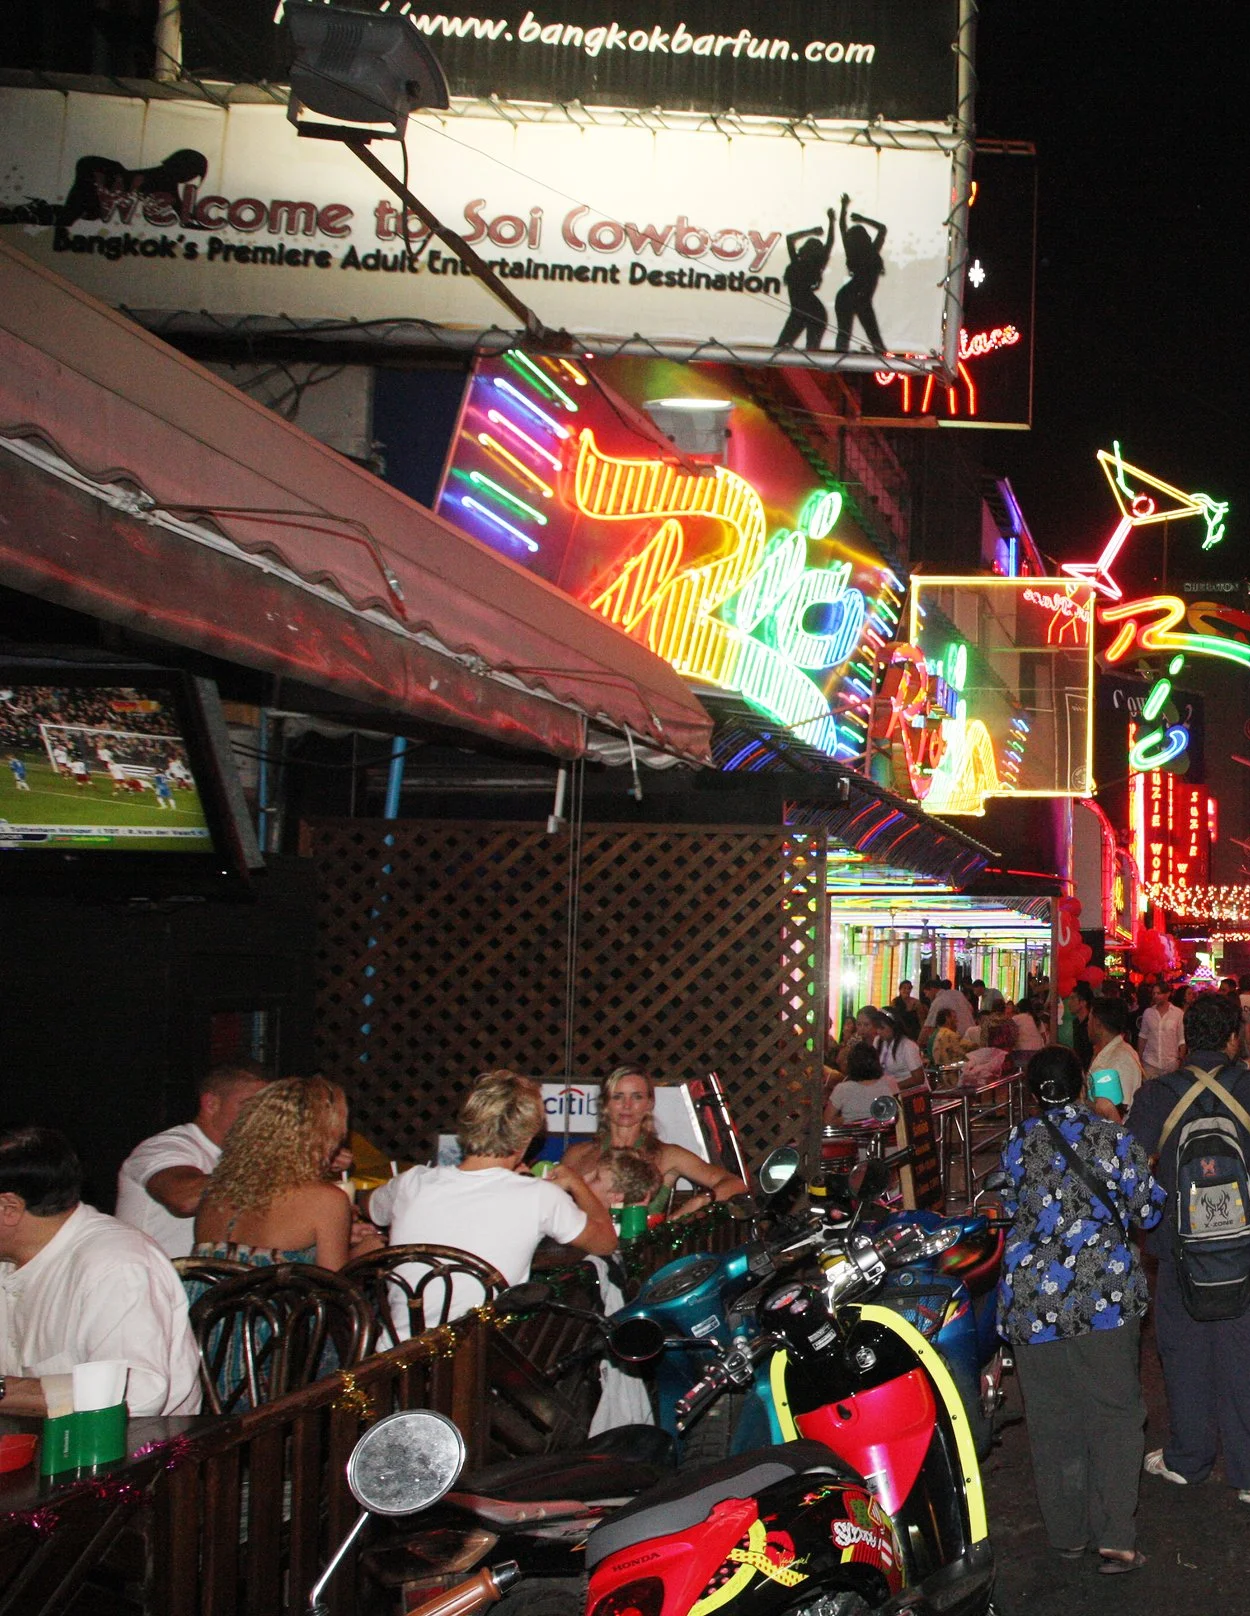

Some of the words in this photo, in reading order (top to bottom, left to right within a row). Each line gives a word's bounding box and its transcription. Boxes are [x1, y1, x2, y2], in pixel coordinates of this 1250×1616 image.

[96, 172, 353, 238] Welcome
[374, 199, 433, 242] to
[462, 199, 544, 250] Soi
[562, 204, 782, 273] Cowboy
[53, 226, 199, 261] Bangkok's
[208, 236, 332, 268] Premiere
[341, 248, 420, 274] Adult
[428, 250, 620, 286] Entrtainment
[629, 261, 782, 294] Destination
[575, 428, 865, 758] Rio
[1189, 791, 1199, 857] SUZIE
[612, 1551, 661, 1573] HONDA
